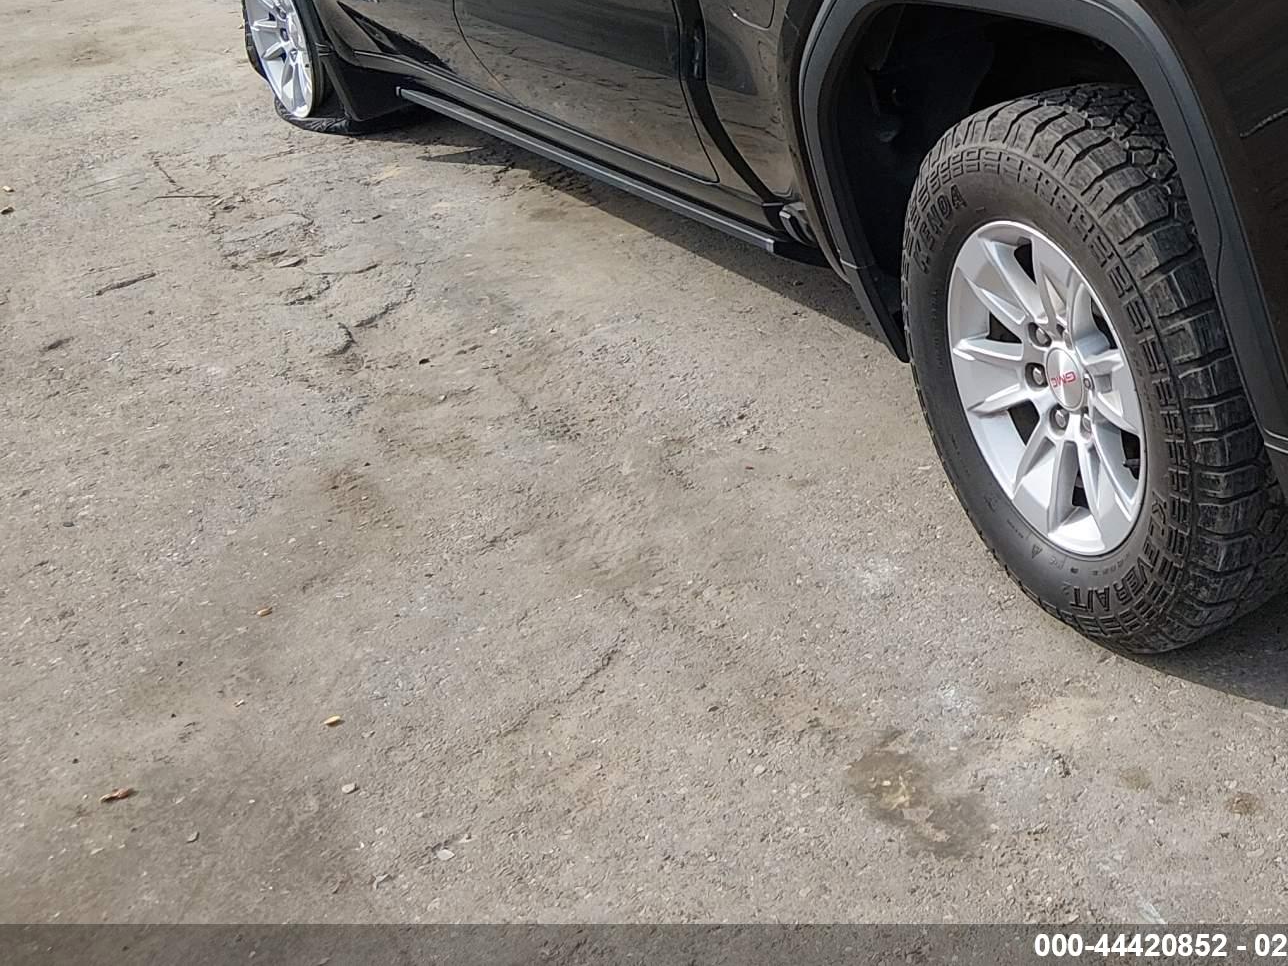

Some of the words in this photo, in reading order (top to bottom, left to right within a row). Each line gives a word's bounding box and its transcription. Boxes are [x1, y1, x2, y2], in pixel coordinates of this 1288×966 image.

[913, 183, 967, 274] KENDA
[1050, 370, 1077, 388] GMC
[1069, 585, 1111, 613] A/T
